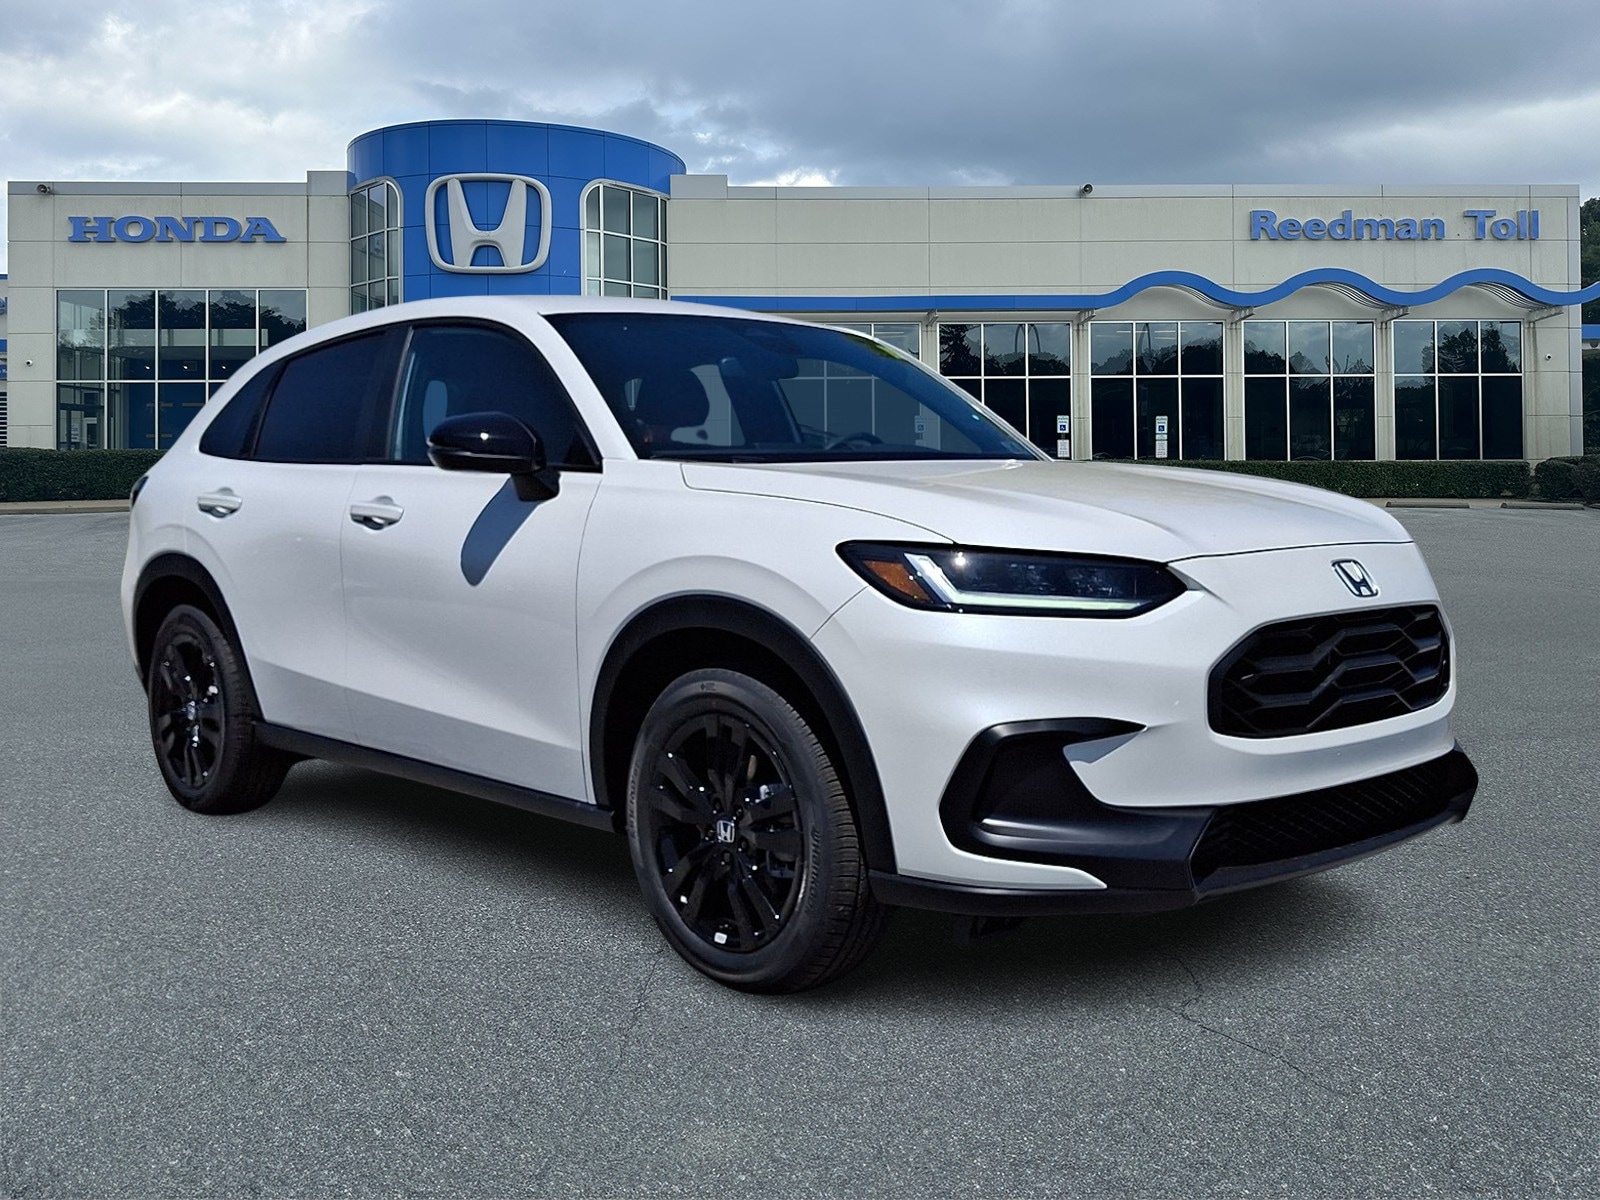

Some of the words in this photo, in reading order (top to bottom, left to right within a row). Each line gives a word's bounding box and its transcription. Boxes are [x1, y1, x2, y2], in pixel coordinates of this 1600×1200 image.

[68, 215, 287, 243] HONDA
[1250, 209, 1446, 241] Reedman
[1464, 210, 1540, 241] Toll
